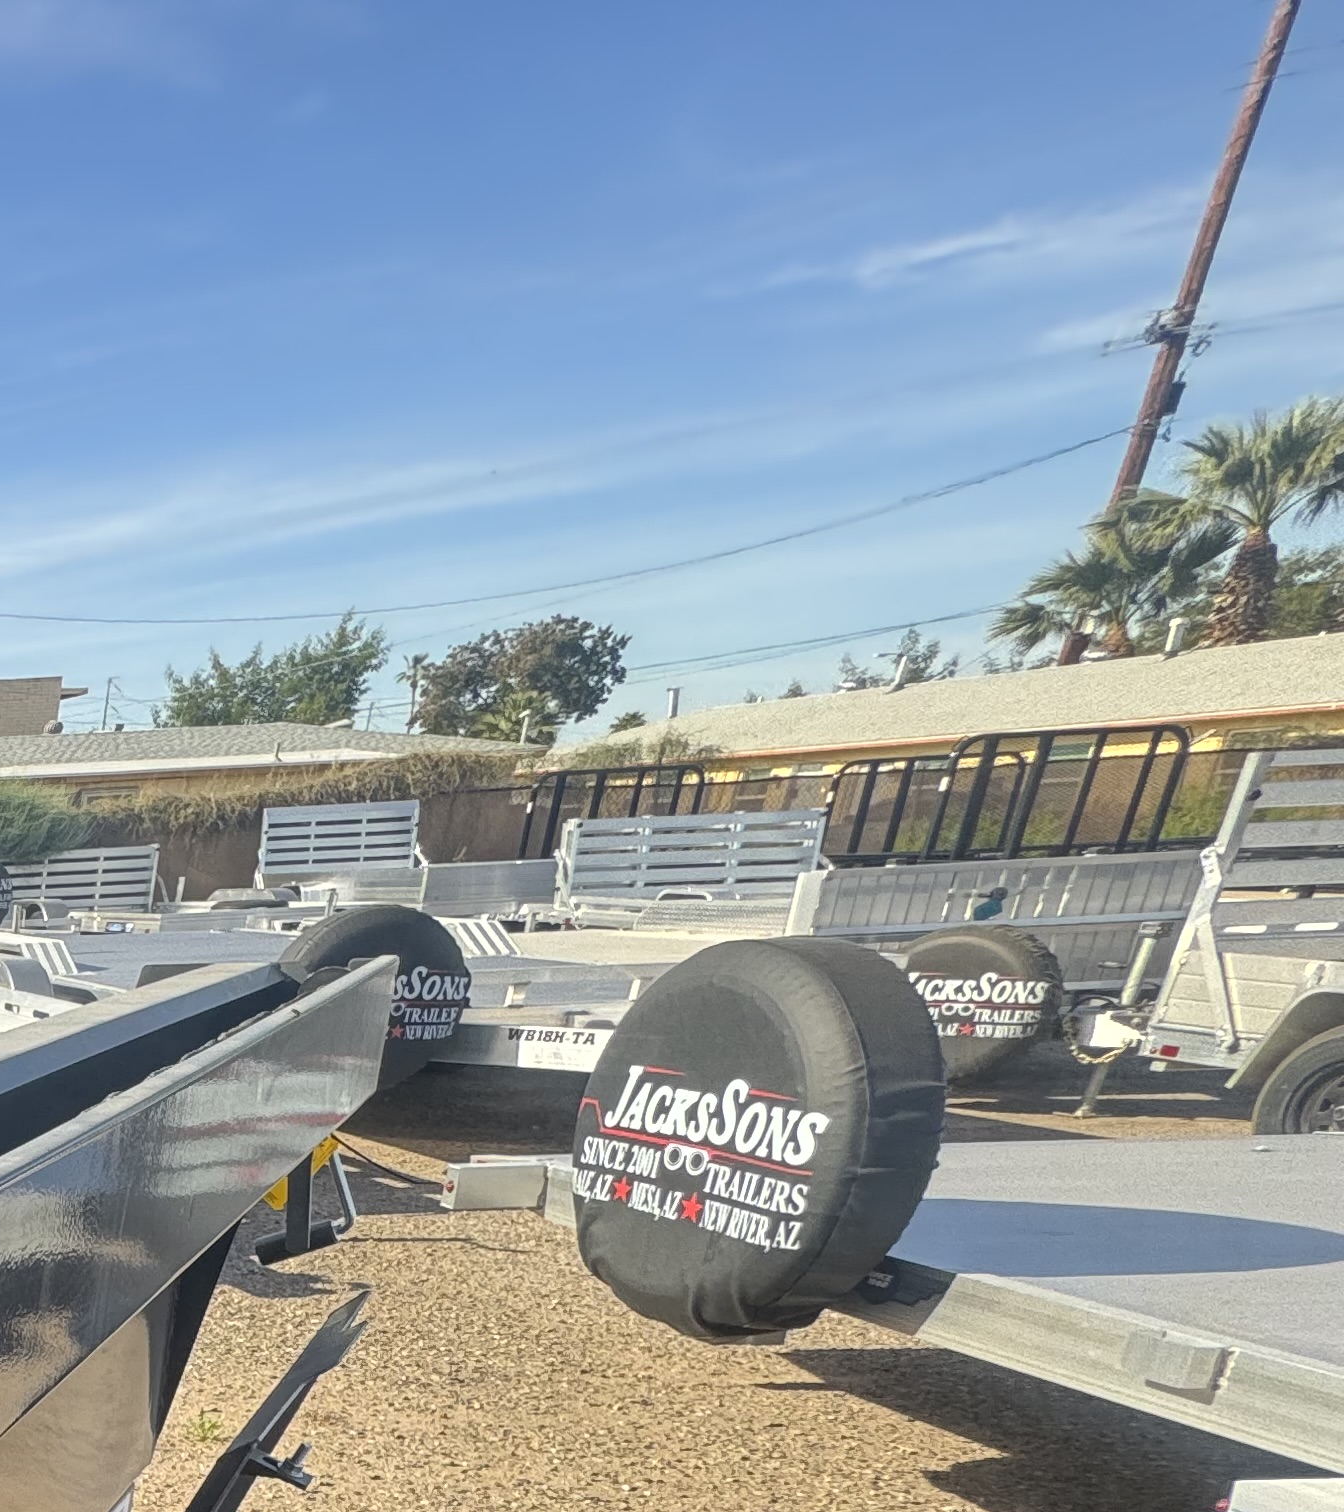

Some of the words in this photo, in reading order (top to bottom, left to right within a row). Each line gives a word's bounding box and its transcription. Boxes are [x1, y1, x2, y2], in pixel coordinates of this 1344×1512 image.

[508, 1028, 595, 1046] WB18H-TA
[973, 1009, 1041, 1024] TRAILERS
[580, 1136, 631, 1172] SINCE
[627, 1146, 662, 1178] 2001
[703, 1163, 810, 1216] TRAILERS
[590, 1174, 614, 1202] AZ
[628, 1181, 661, 1221] MESA,
[661, 1191, 683, 1220] AZ
[699, 1199, 732, 1233] NEW
[727, 1207, 771, 1253] RIVER,
[772, 1221, 803, 1250] AZ
